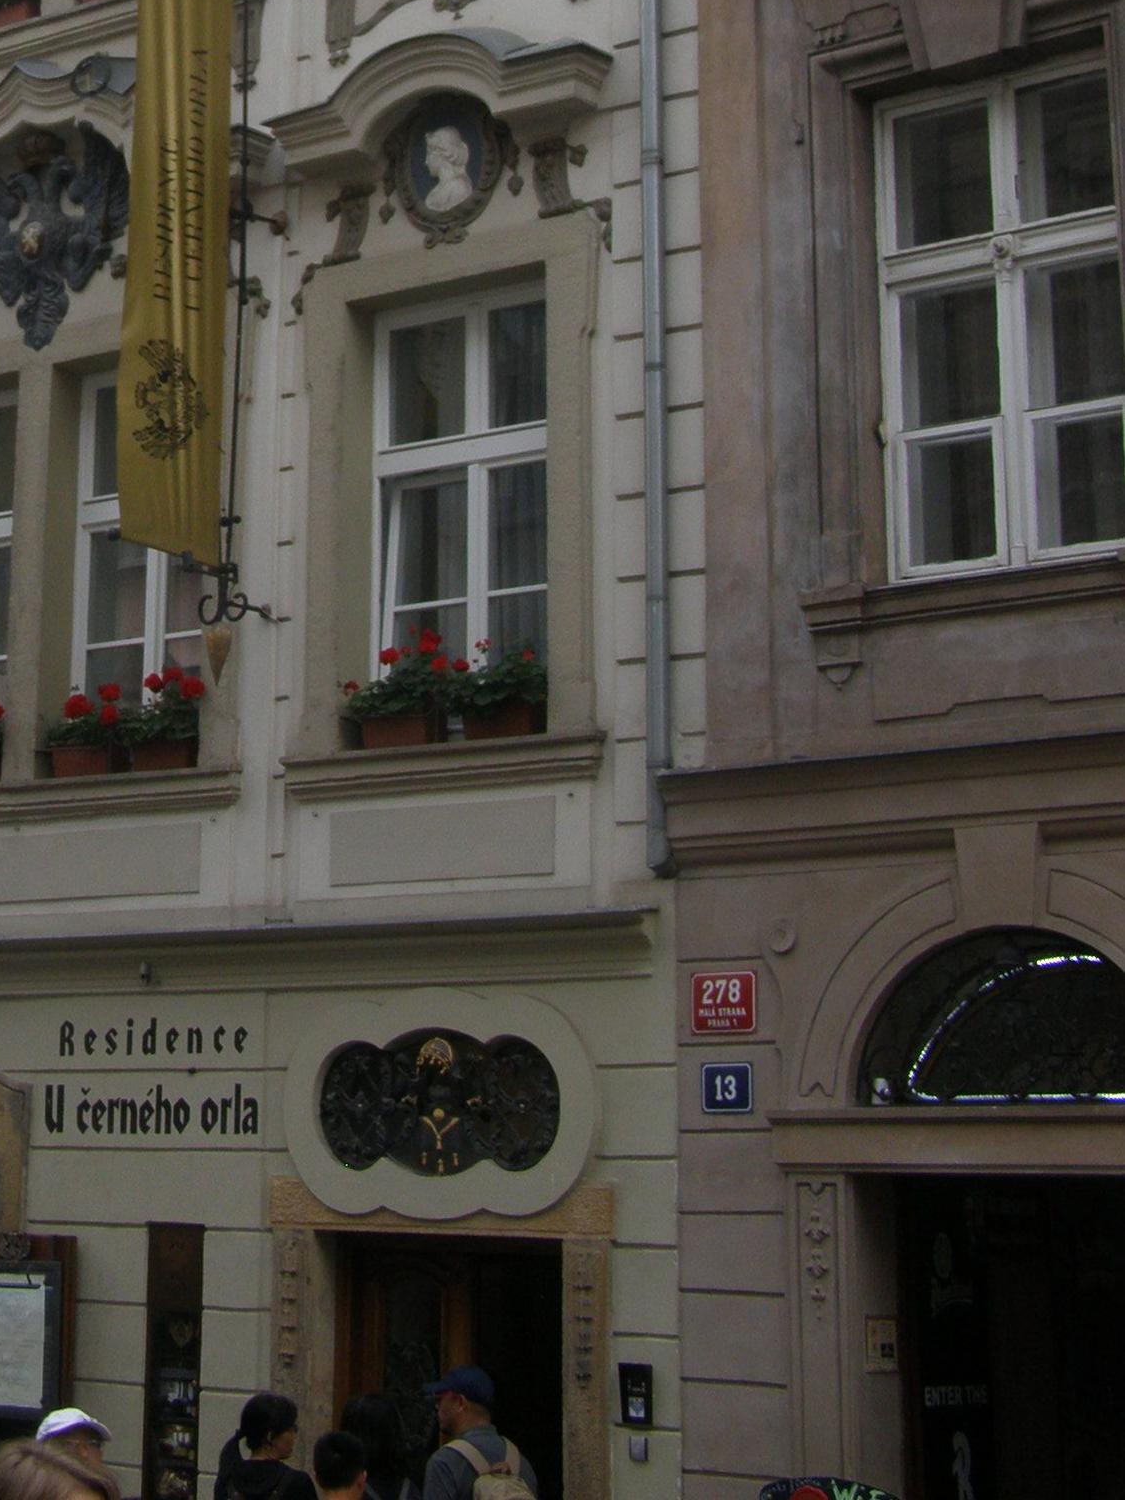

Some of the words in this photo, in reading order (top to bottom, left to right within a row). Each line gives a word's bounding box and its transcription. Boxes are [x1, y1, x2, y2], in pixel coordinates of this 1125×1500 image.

[188, 48, 208, 128] ORLA
[152, 134, 178, 302] RESIDENCE
[702, 979, 741, 1004] 278
[59, 1017, 248, 1056] Residence
[715, 1075, 737, 1101] 13
[44, 1084, 65, 1134] U
[76, 1084, 190, 1134] černého
[200, 1083, 258, 1134] orla
[924, 1386, 963, 1407] ENTER
